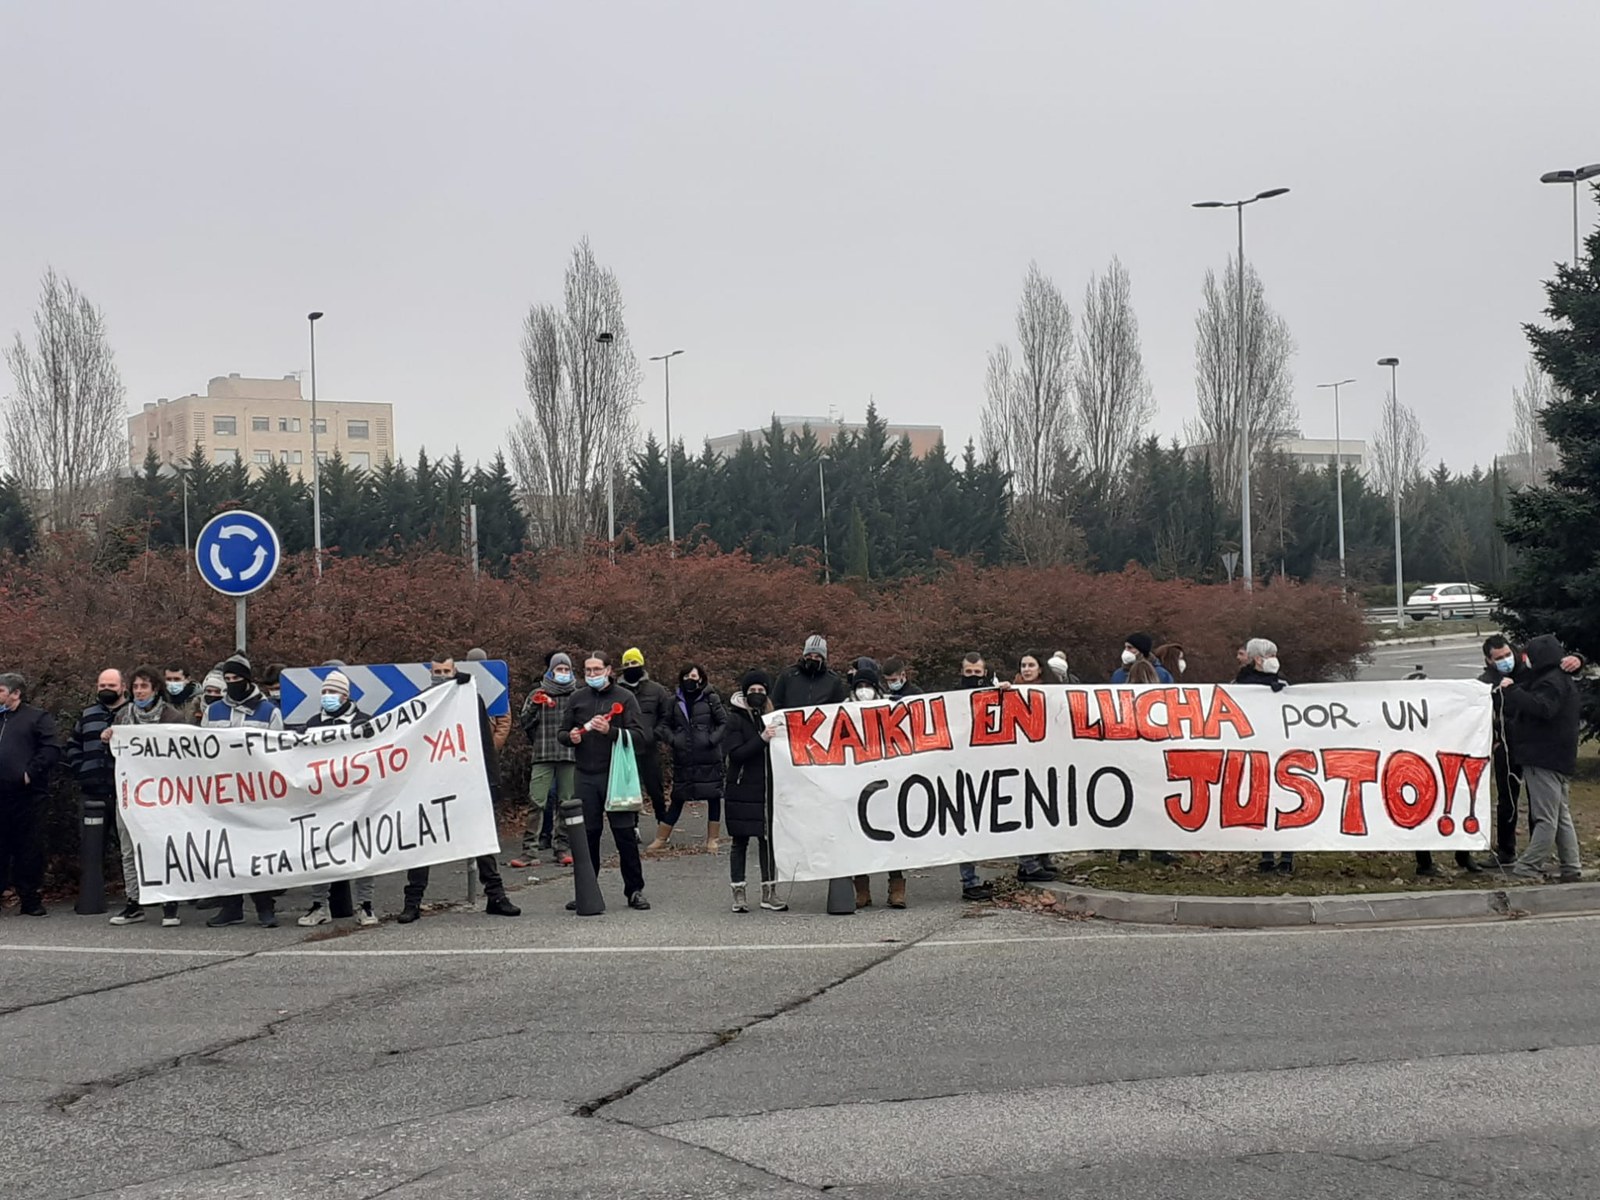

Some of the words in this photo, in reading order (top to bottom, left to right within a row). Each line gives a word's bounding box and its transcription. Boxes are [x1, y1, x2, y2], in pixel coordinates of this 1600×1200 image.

[230, 700, 427, 755] -FLEXIBILDAD
[306, 743, 408, 796] JUSTO
[423, 723, 469, 763] YA!
[785, 696, 953, 765] KAIKU
[969, 688, 1046, 746] EN
[1066, 685, 1254, 741] LUCHA
[1281, 702, 1360, 739] POR
[1382, 698, 1429, 732] UN
[857, 765, 1133, 841] CONVENIO
[1164, 749, 1490, 836] JUSTO!!
[137, 828, 236, 886] LANA
[291, 795, 457, 872] TECNOLAT
